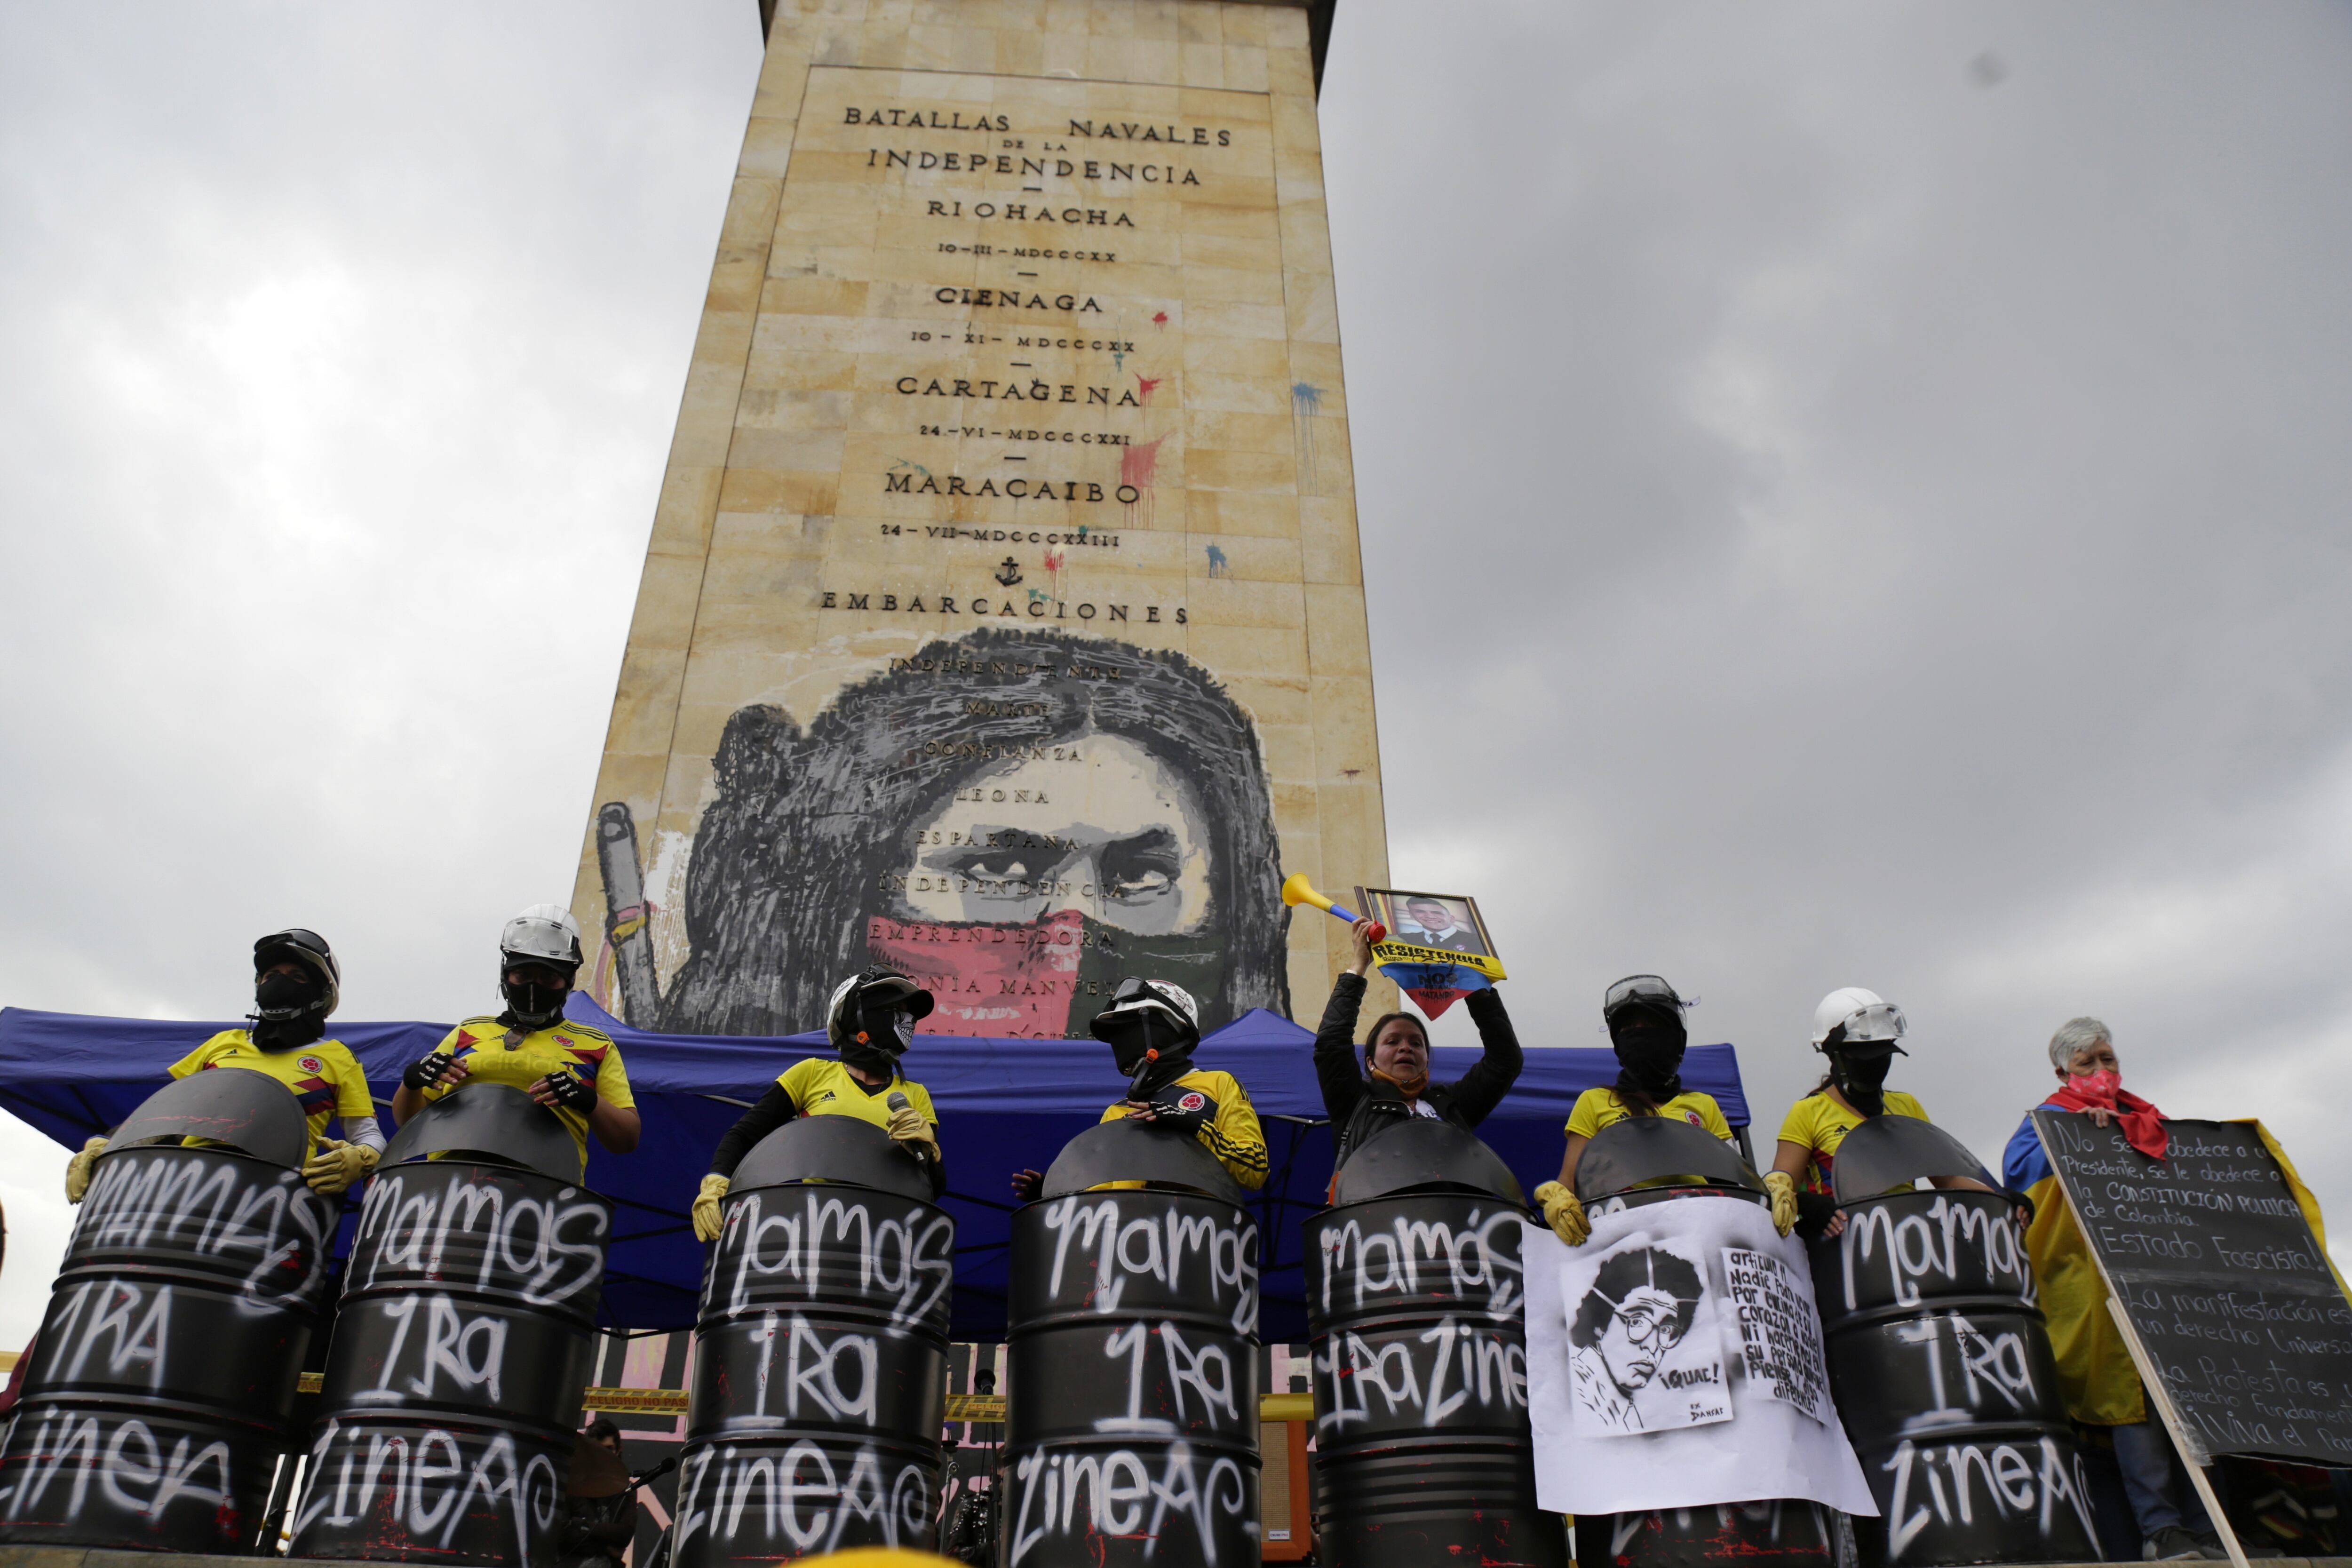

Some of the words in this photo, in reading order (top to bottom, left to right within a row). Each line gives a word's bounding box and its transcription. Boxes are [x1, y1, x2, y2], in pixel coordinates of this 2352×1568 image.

[844, 107, 1009, 132] BATALLAS
[1069, 120, 1231, 146] NAVALES
[1003, 140, 1024, 149] DE
[1044, 143, 1067, 151] LA
[868, 149, 1200, 185] INDEPENDENCIA
[928, 201, 1135, 228] RIOHACHA
[936, 287, 1103, 313] CIENAGA
[897, 377, 1140, 407] CARTAGENA
[885, 473, 1140, 504] MARACAIBO
[821, 592, 1188, 624] EMBARCACIONES
[890, 658, 1121, 679] INDEPENDENTE
[966, 702, 1050, 717] MARTE
[924, 741, 1082, 762] CONFIANZA
[957, 788, 1049, 804] LEONA
[916, 830, 1078, 850] ESPARTANA
[879, 876, 1125, 898] INDEPENDENCIA
[870, 924, 1113, 947] EMPRENDEDORA
[2053, 1120, 2094, 1155] No
[2175, 1161, 2191, 1181] le
[2200, 1162, 2265, 1183] obedece
[2073, 1177, 2094, 1200] la
[2084, 1201, 2107, 1218] de
[1730, 1269, 1771, 1290] Nadie
[2120, 1275, 2166, 1311] La
[2138, 1318, 2166, 1335] un
[2174, 1314, 2259, 1345] derecho
[2266, 1328, 2352, 1354] Universa
[2153, 1351, 2193, 1383] La
[2198, 1356, 2304, 1393] Protesta
[2307, 1380, 2330, 1397] es
[589, 1395, 640, 1406] PELIGRO
[644, 1397, 660, 1406] NO
[664, 1398, 689, 1407] PAS
[2169, 1383, 2241, 1408] derecho
[2251, 1392, 2352, 1424] Fundament
[2281, 1424, 2307, 1447] el
[2317, 1428, 2352, 1452] Par
